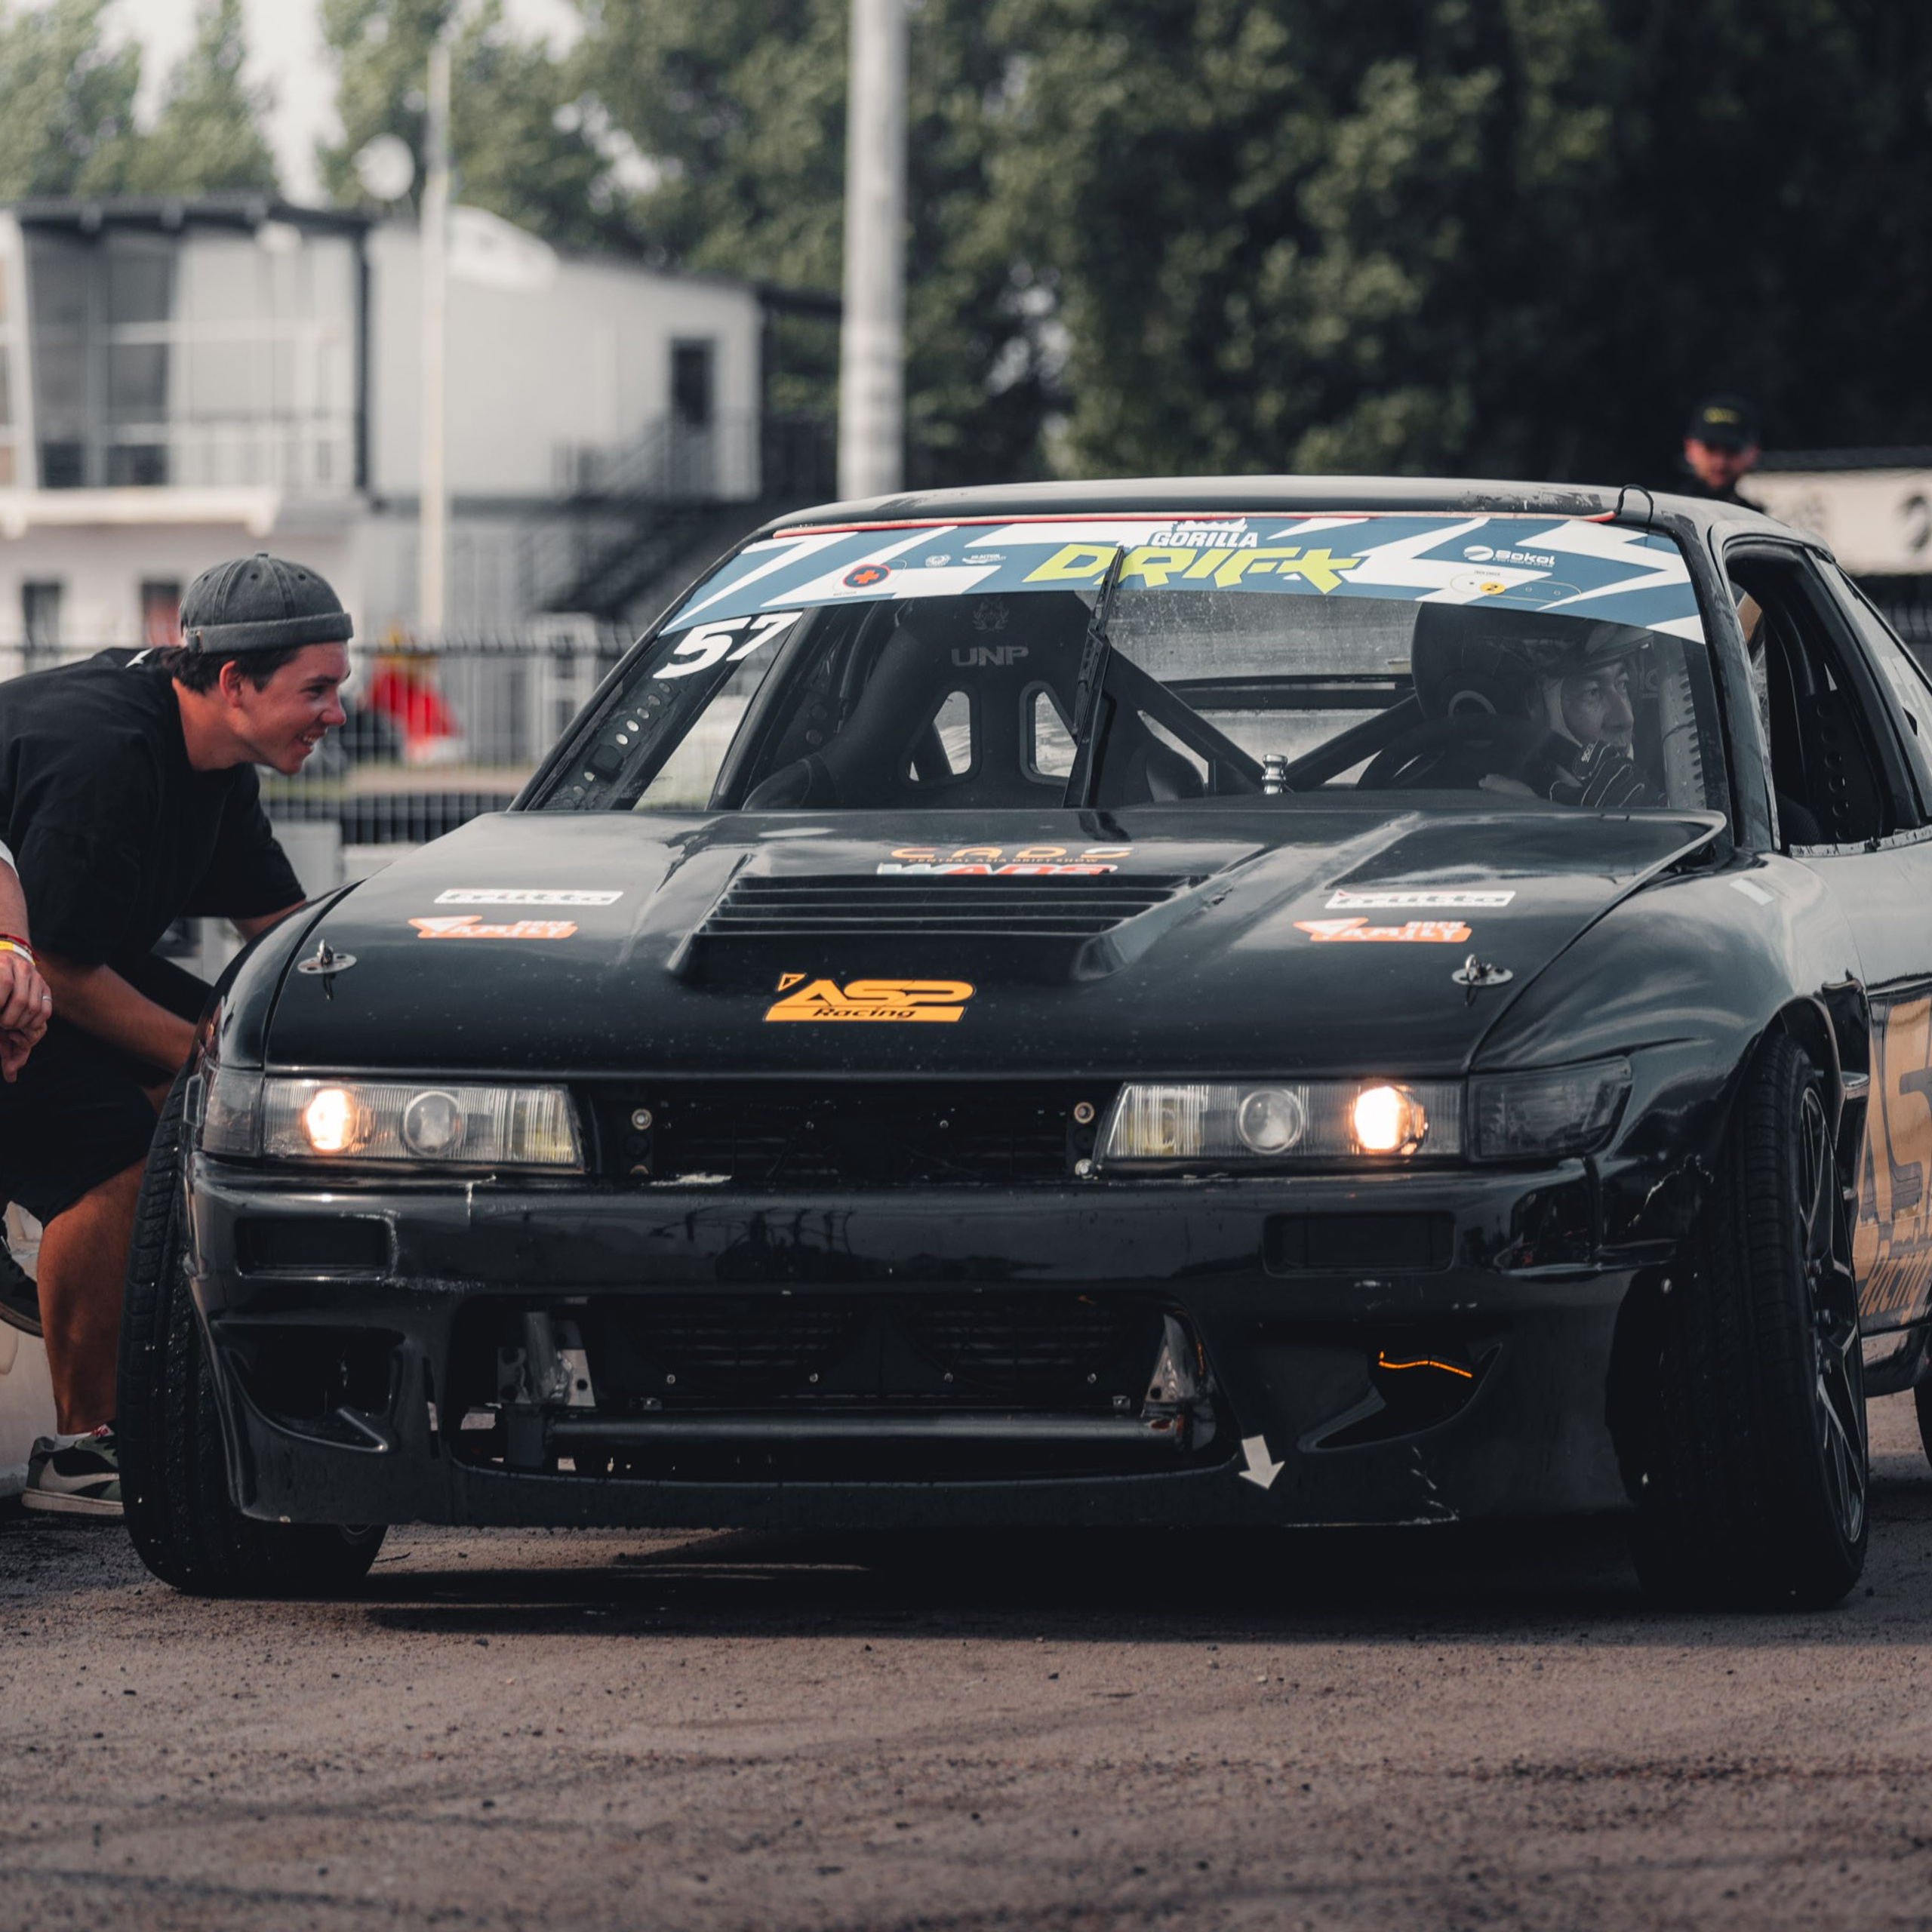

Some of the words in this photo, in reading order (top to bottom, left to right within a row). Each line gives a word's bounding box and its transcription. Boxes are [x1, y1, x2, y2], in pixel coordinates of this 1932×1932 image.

[1150, 531, 1259, 549] GORILLA
[1495, 549, 1555, 565] Sokol
[1022, 543, 1361, 595] DRIFT
[652, 611, 804, 679] 57
[951, 645, 1029, 666] UNP
[772, 979, 974, 1008] ASP
[811, 1007, 916, 1018] Racing
